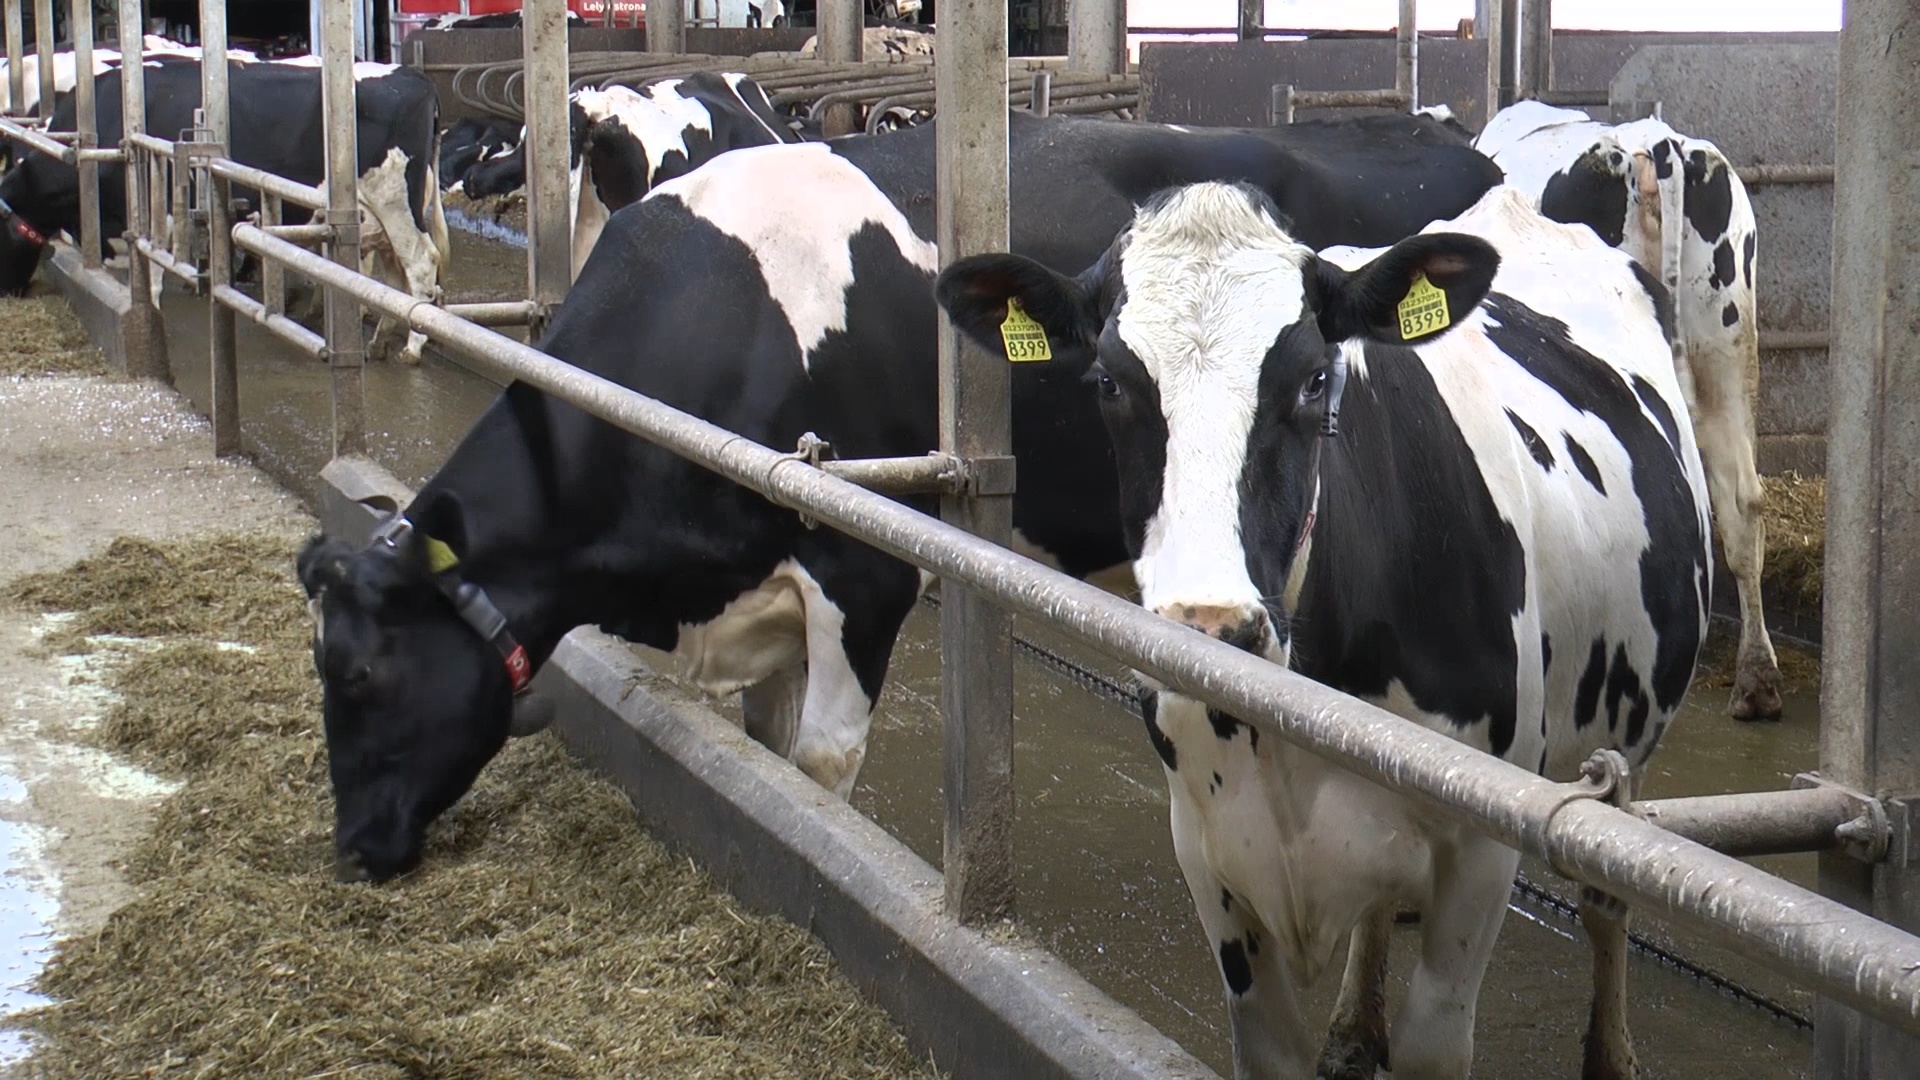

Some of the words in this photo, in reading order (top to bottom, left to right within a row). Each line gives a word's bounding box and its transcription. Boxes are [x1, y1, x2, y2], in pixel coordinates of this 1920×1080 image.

[584, 1, 604, 13] Lely
[607, 2, 646, 11] strona
[1402, 308, 1444, 335] 8399
[1008, 340, 1046, 357] 8399
